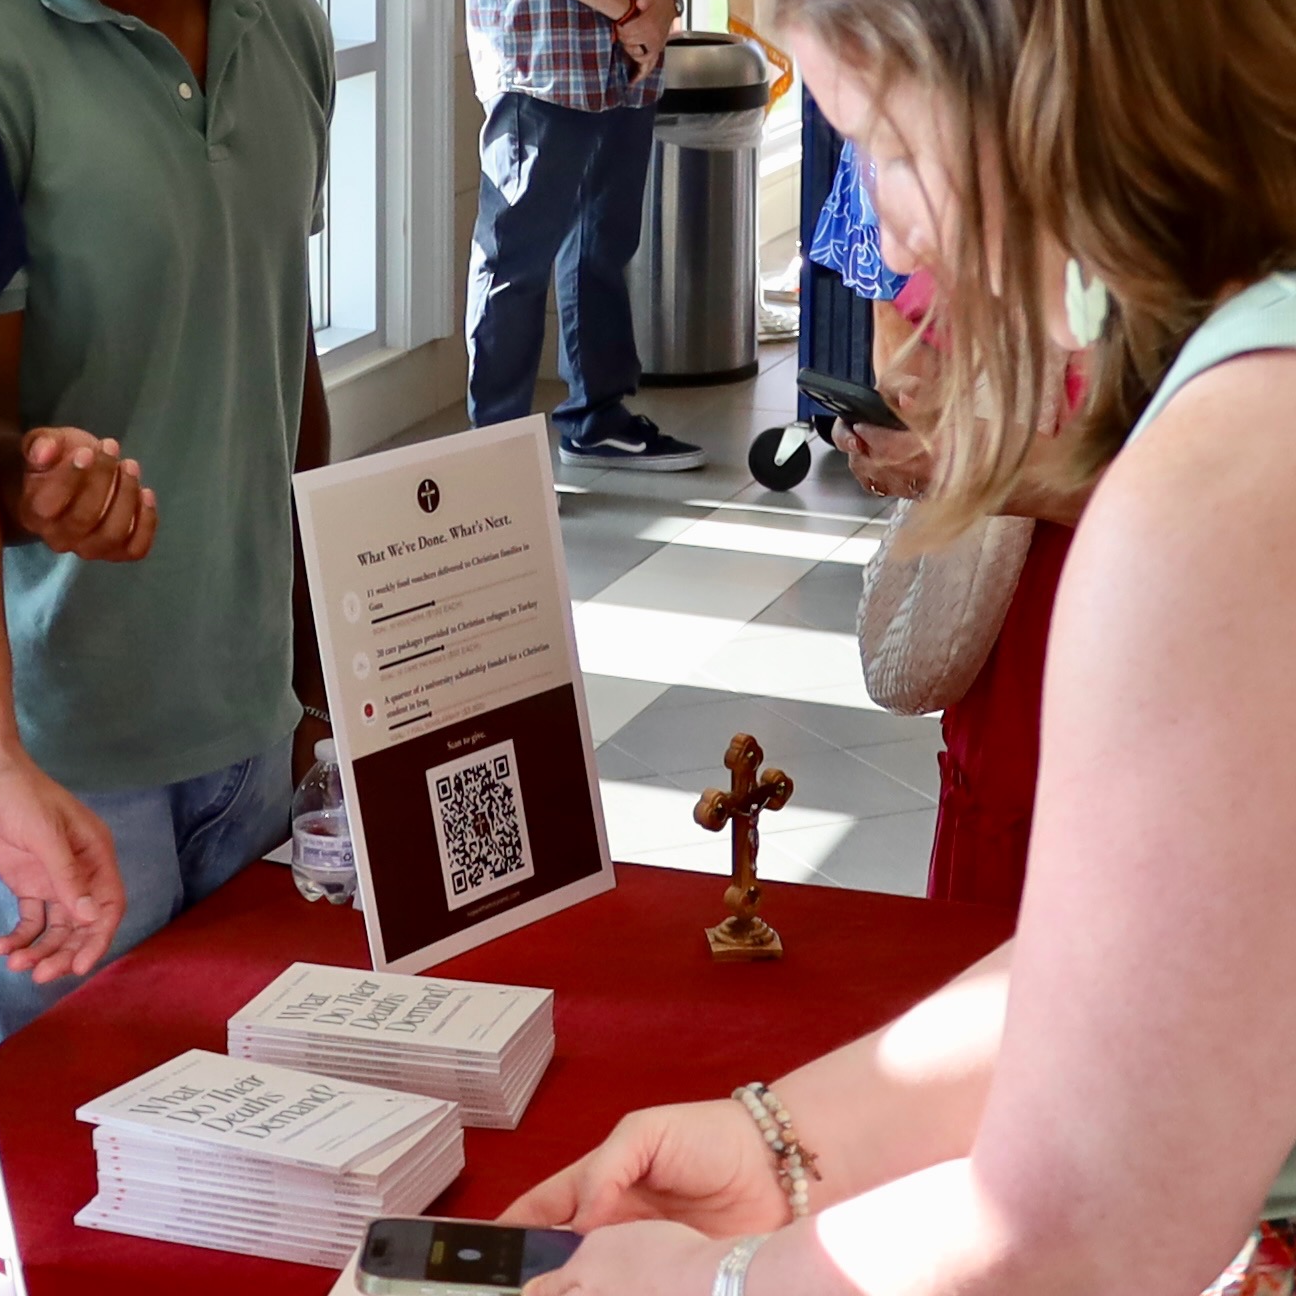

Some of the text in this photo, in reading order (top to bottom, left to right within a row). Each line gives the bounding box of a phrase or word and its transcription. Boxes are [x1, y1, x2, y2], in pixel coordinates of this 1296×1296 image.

[357, 515, 512, 566] What We've Done. What's Next.
[275, 992, 332, 1020] What
[332, 979, 381, 1007] Their
[349, 992, 408, 1030] Deaths
[384, 981, 459, 1033] Demand?
[312, 1006, 354, 1025] Do
[128, 1084, 205, 1115] What
[165, 1103, 216, 1124] Do
[206, 1073, 265, 1105] Their
[200, 1089, 285, 1133] Deaths
[234, 1082, 347, 1139] Demand?
